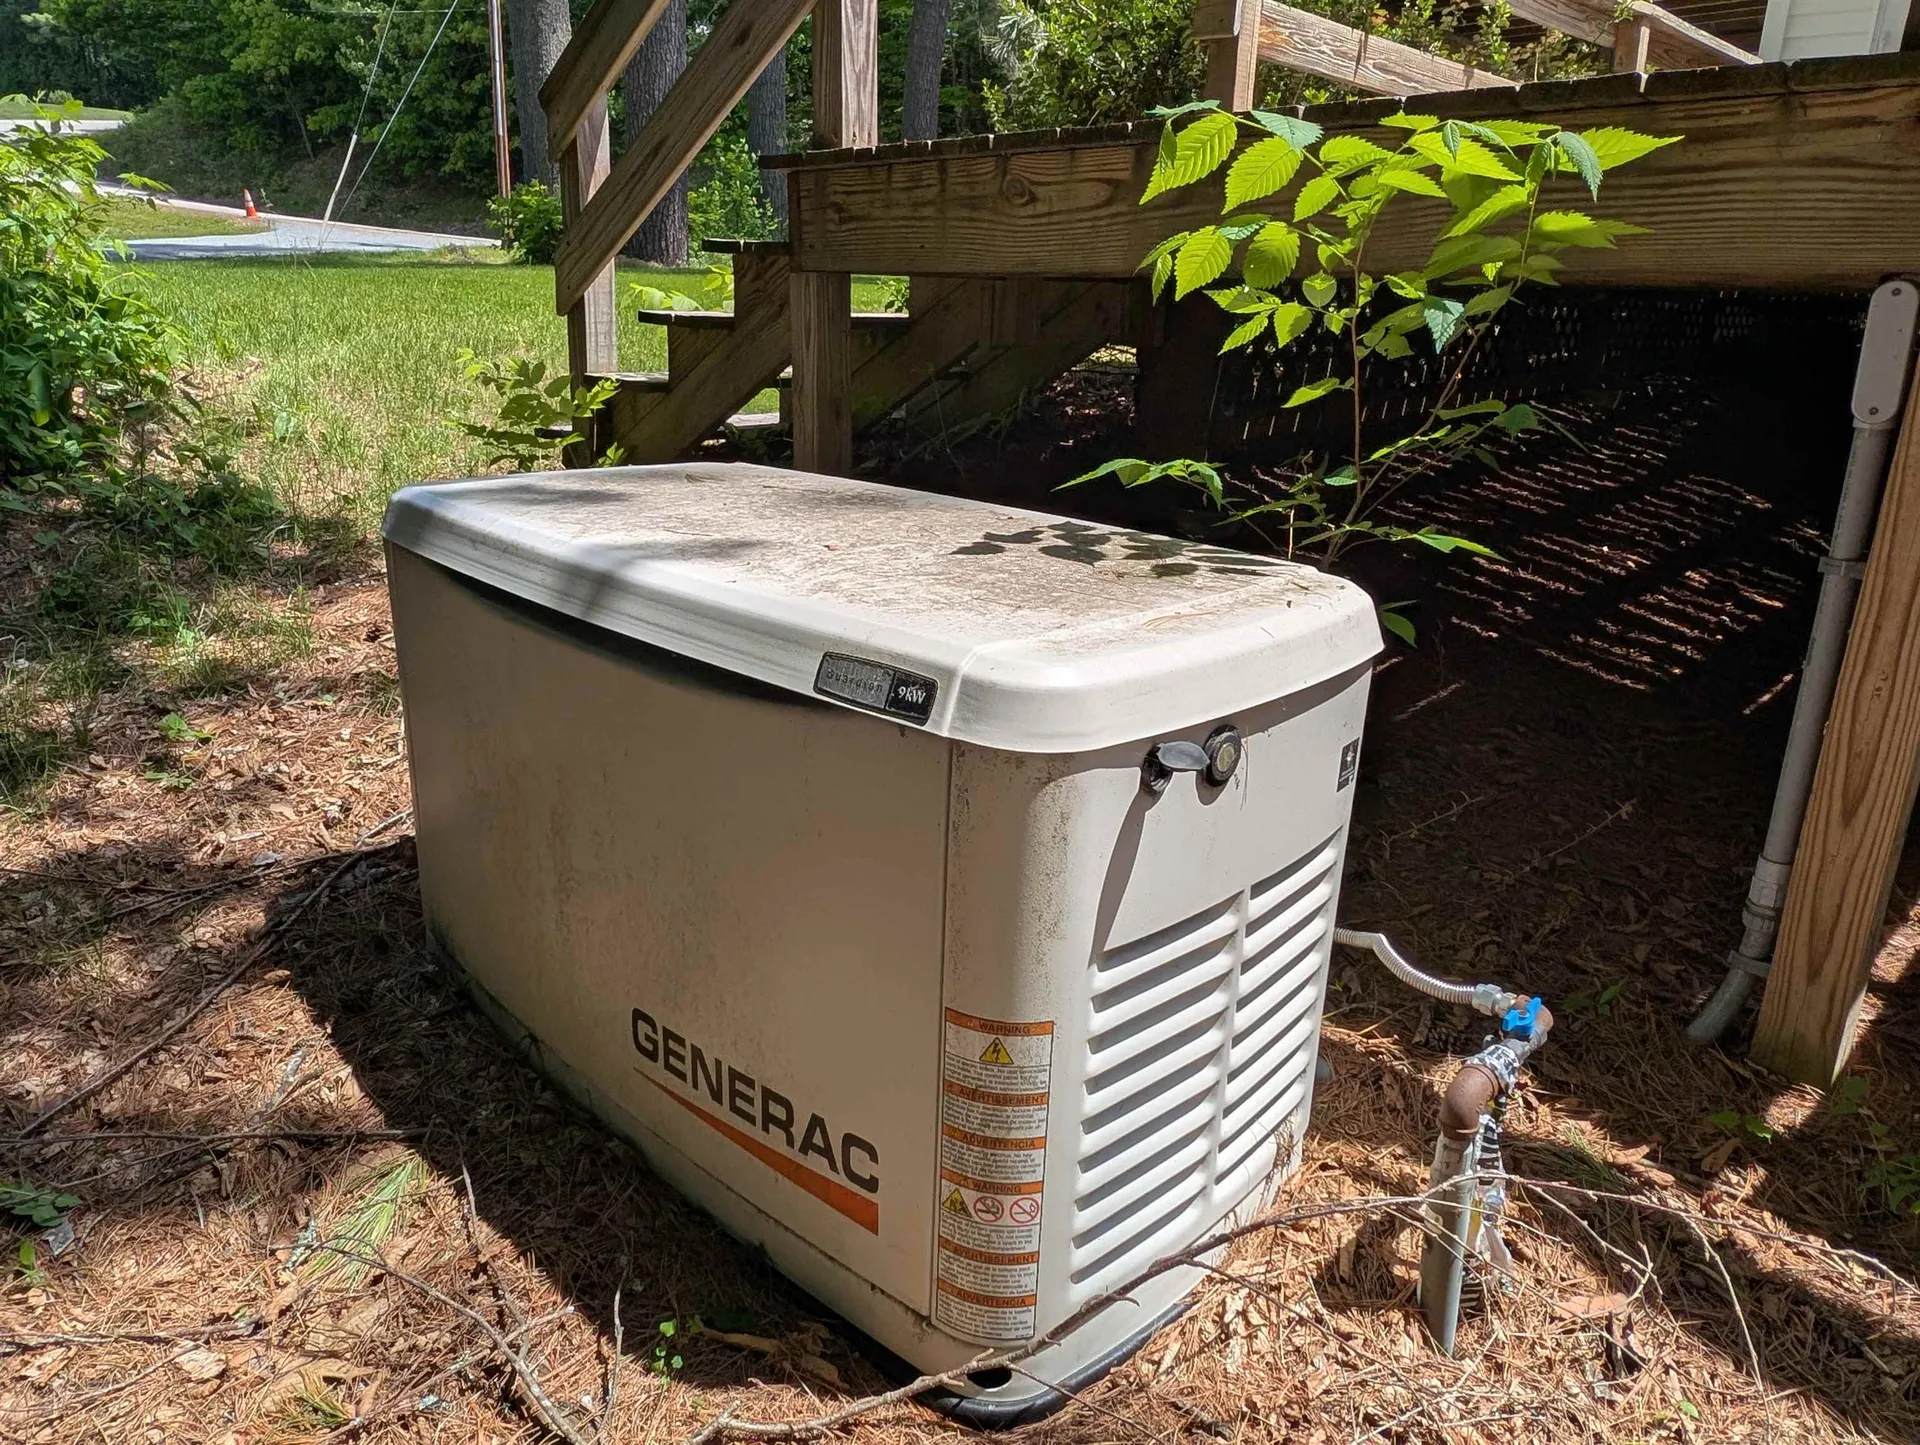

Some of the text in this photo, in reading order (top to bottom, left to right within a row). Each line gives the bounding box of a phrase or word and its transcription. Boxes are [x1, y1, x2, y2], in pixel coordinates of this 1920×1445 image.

[898, 685, 926, 705] 9kW
[979, 1020, 1031, 1035] WARNING
[631, 1007, 880, 1194] GENERAC
[958, 1088, 1046, 1104] AVERTISSEMENT
[962, 1133, 1036, 1148] ADVERTENCIA
[972, 1180, 1022, 1193] WARNING
